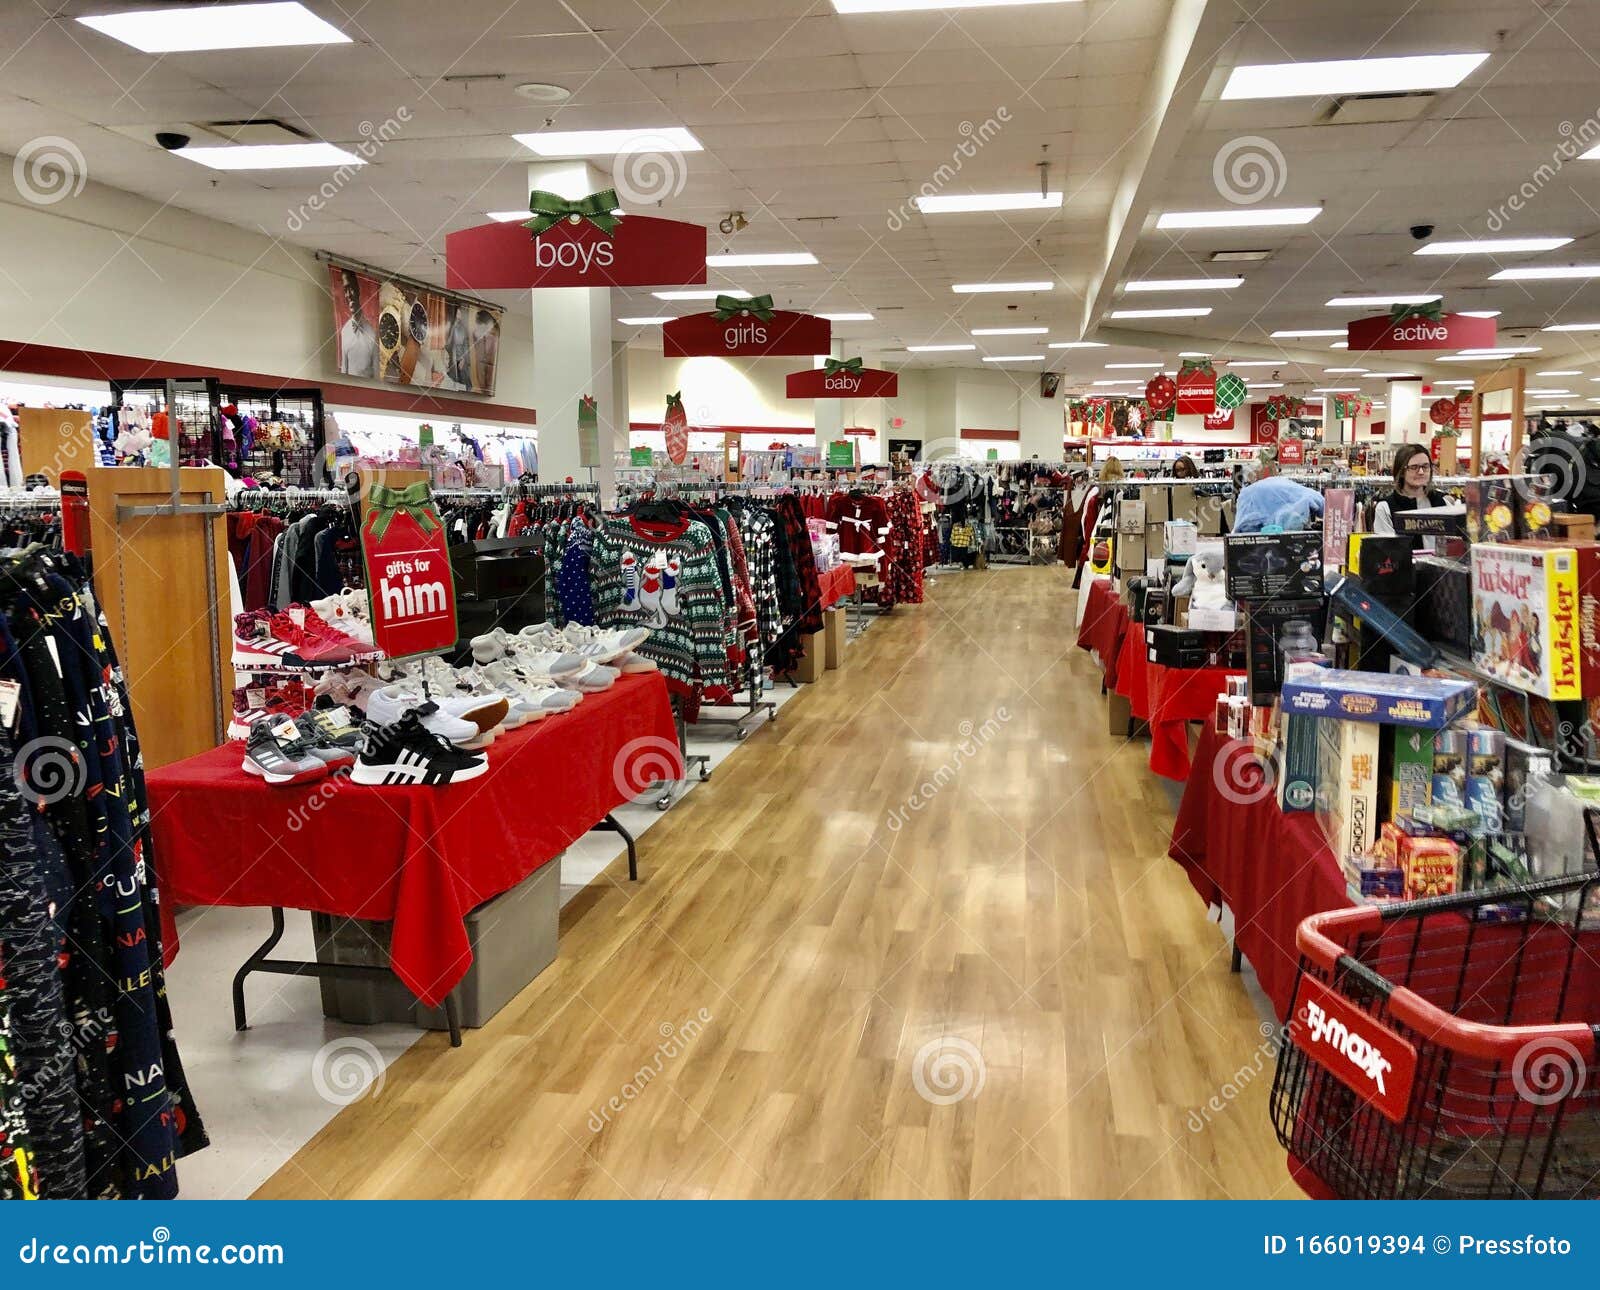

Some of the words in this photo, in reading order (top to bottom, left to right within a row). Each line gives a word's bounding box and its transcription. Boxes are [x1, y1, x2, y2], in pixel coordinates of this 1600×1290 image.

[535, 235, 614, 274] boys
[724, 322, 767, 349] girls
[1393, 323, 1449, 341] active
[825, 376, 862, 392] baby
[1178, 387, 1214, 397] pajamas
[386, 560, 413, 578] gifts
[414, 558, 430, 573] for
[379, 574, 448, 620] him
[1553, 582, 1576, 694] Twister
[1352, 797, 1366, 860] ONOPOLY
